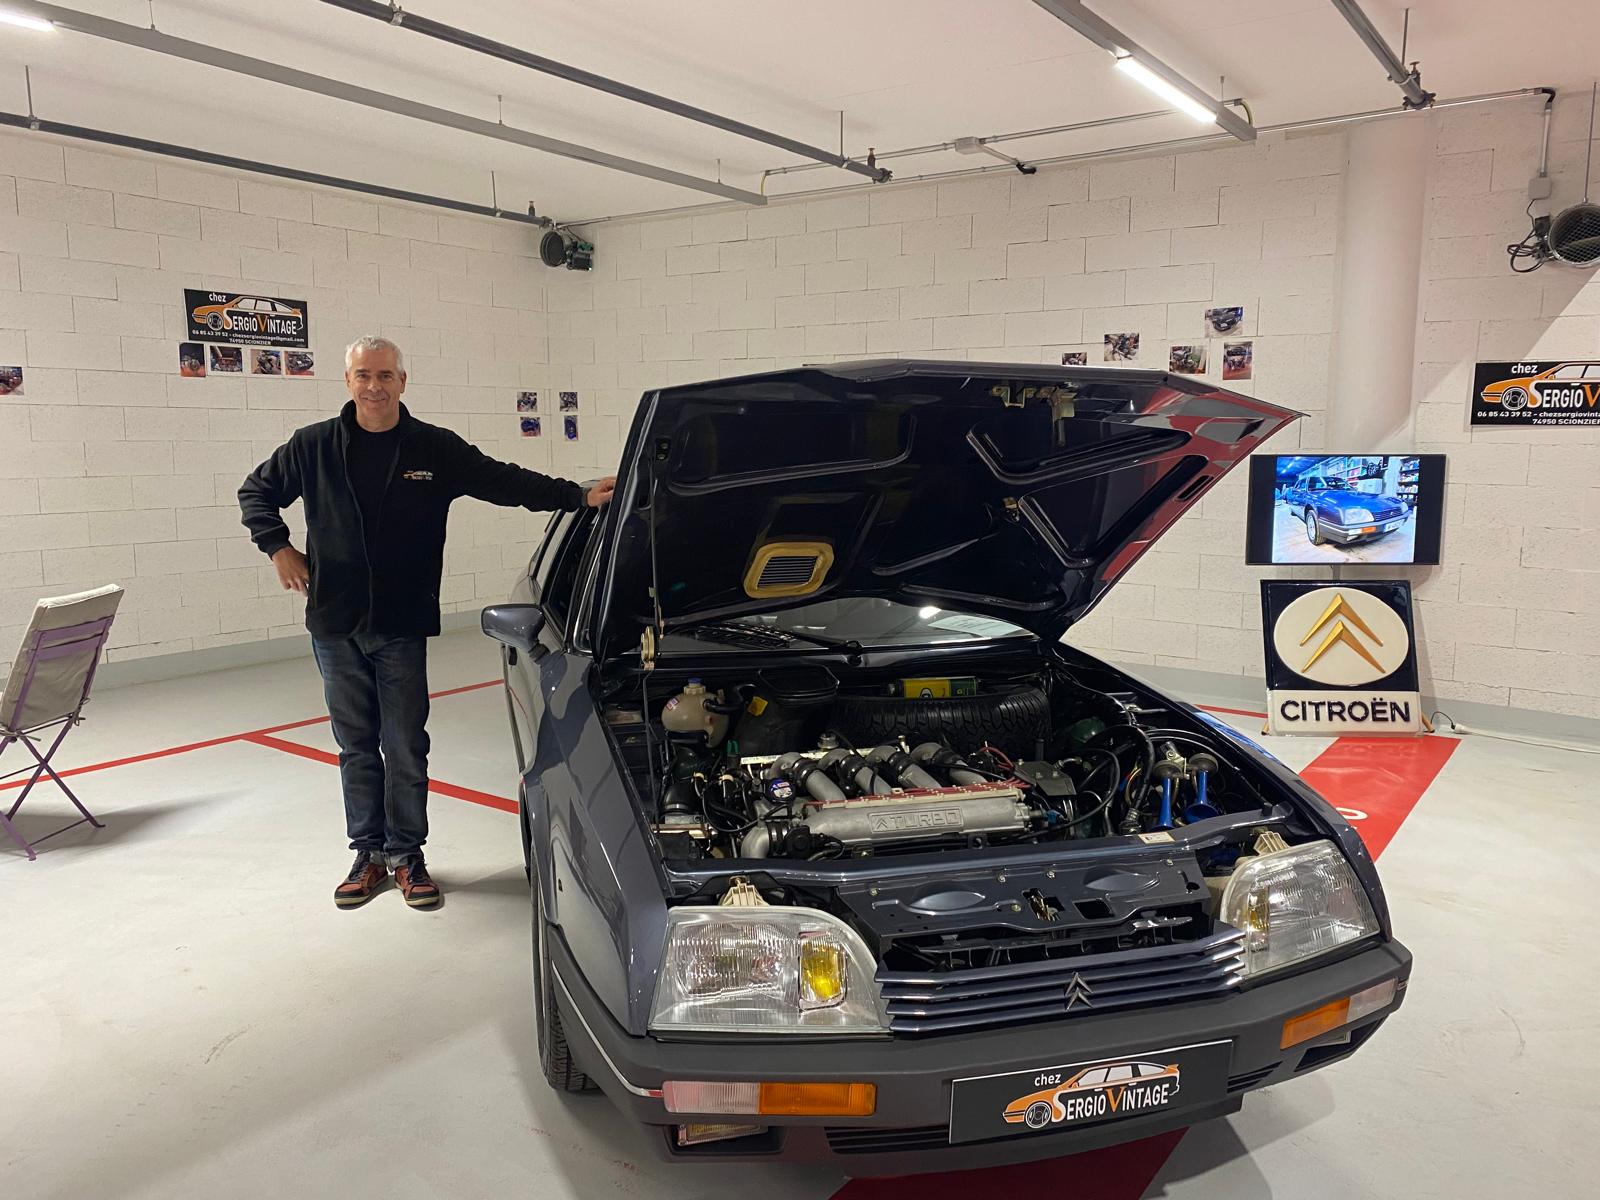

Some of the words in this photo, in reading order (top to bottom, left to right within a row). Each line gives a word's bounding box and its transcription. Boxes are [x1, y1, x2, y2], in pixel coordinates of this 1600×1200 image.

[208, 292, 227, 303] chez
[222, 309, 257, 331] SERGIO
[256, 315, 297, 335] VINTAGE
[1511, 363, 1538, 374] chez
[1527, 380, 1584, 408] SERGIO
[1280, 697, 1411, 722] CITROËN
[889, 812, 961, 829] TURBO
[1034, 1073, 1062, 1087] chez
[1051, 1089, 1107, 1123] SERGIO
[1105, 1083, 1170, 1113] VINTAGE
